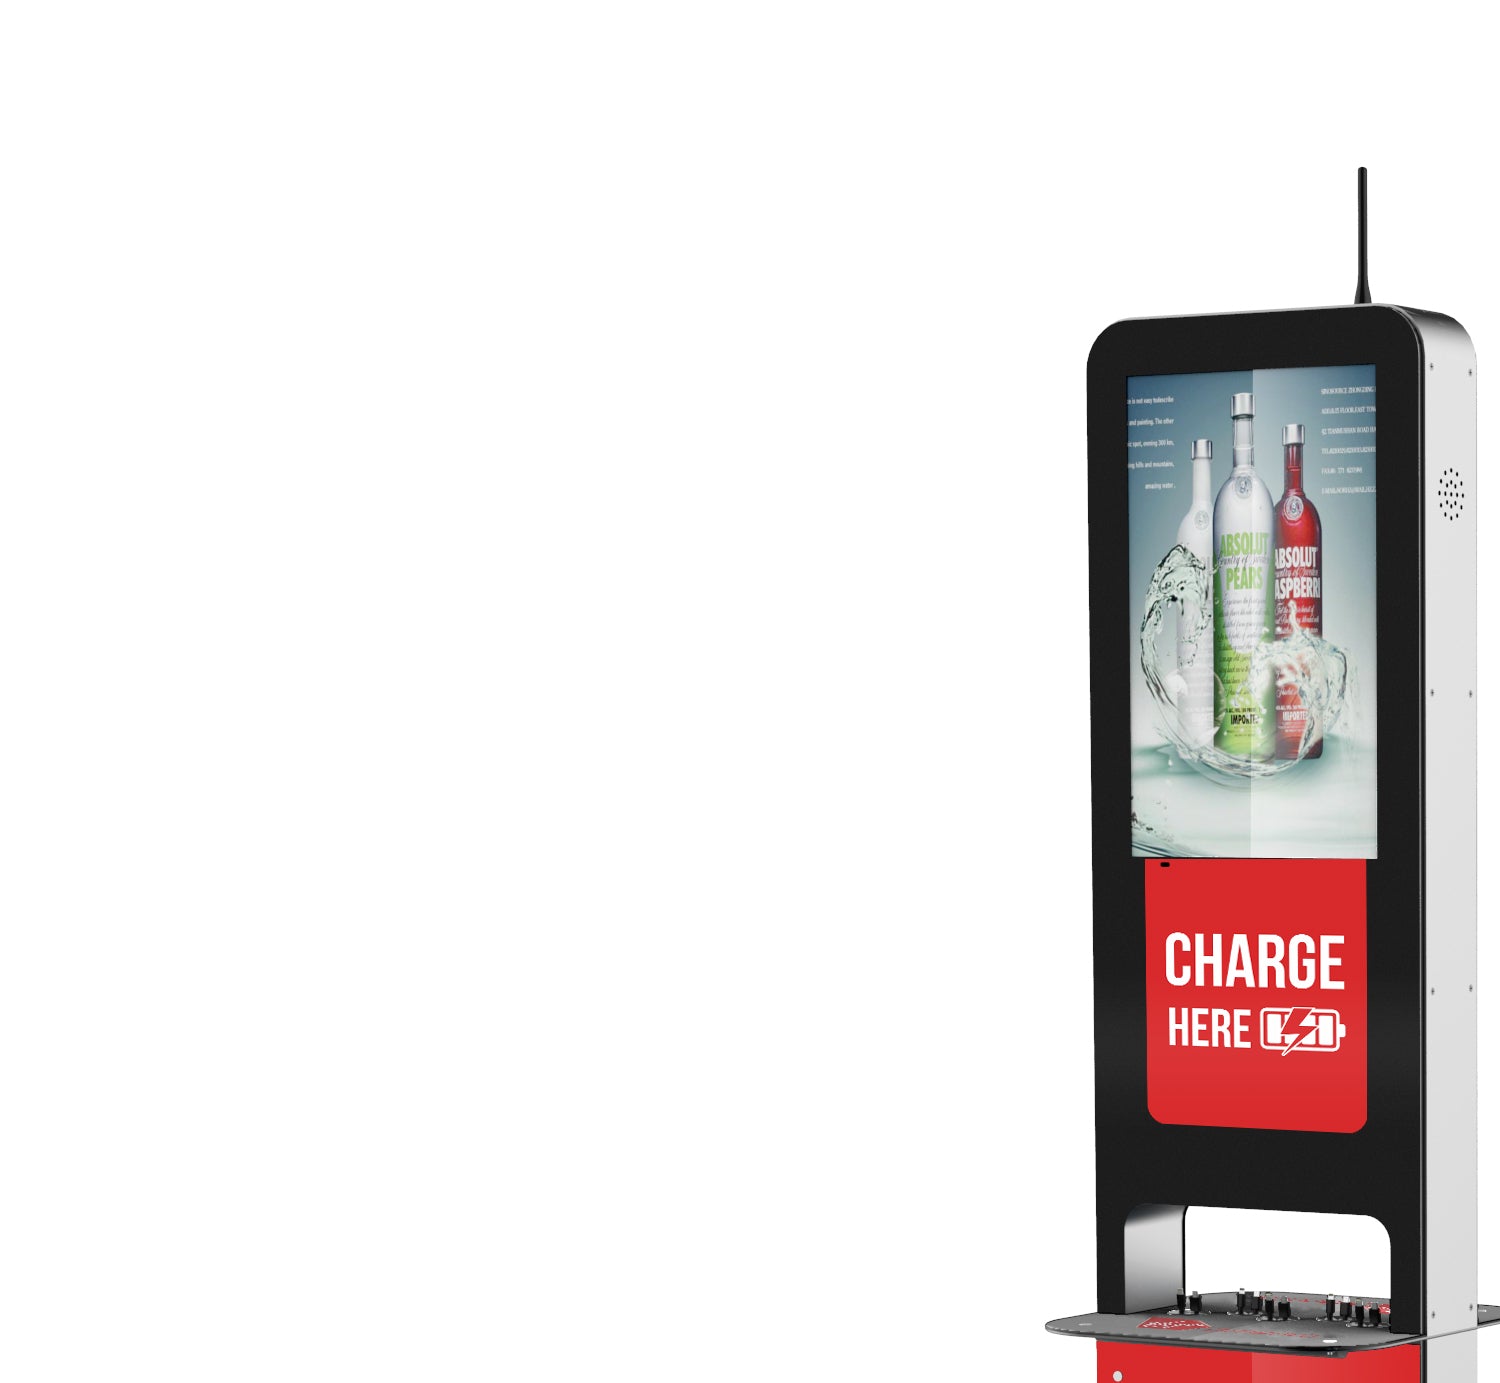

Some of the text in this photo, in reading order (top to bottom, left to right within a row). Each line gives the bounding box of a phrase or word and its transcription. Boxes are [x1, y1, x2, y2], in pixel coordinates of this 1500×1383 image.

[1220, 532, 1269, 557] ABSOLUT
[1226, 566, 1263, 591] PEARS
[1166, 932, 1344, 989] CHARGE
[1169, 1007, 1251, 1048] HERE
